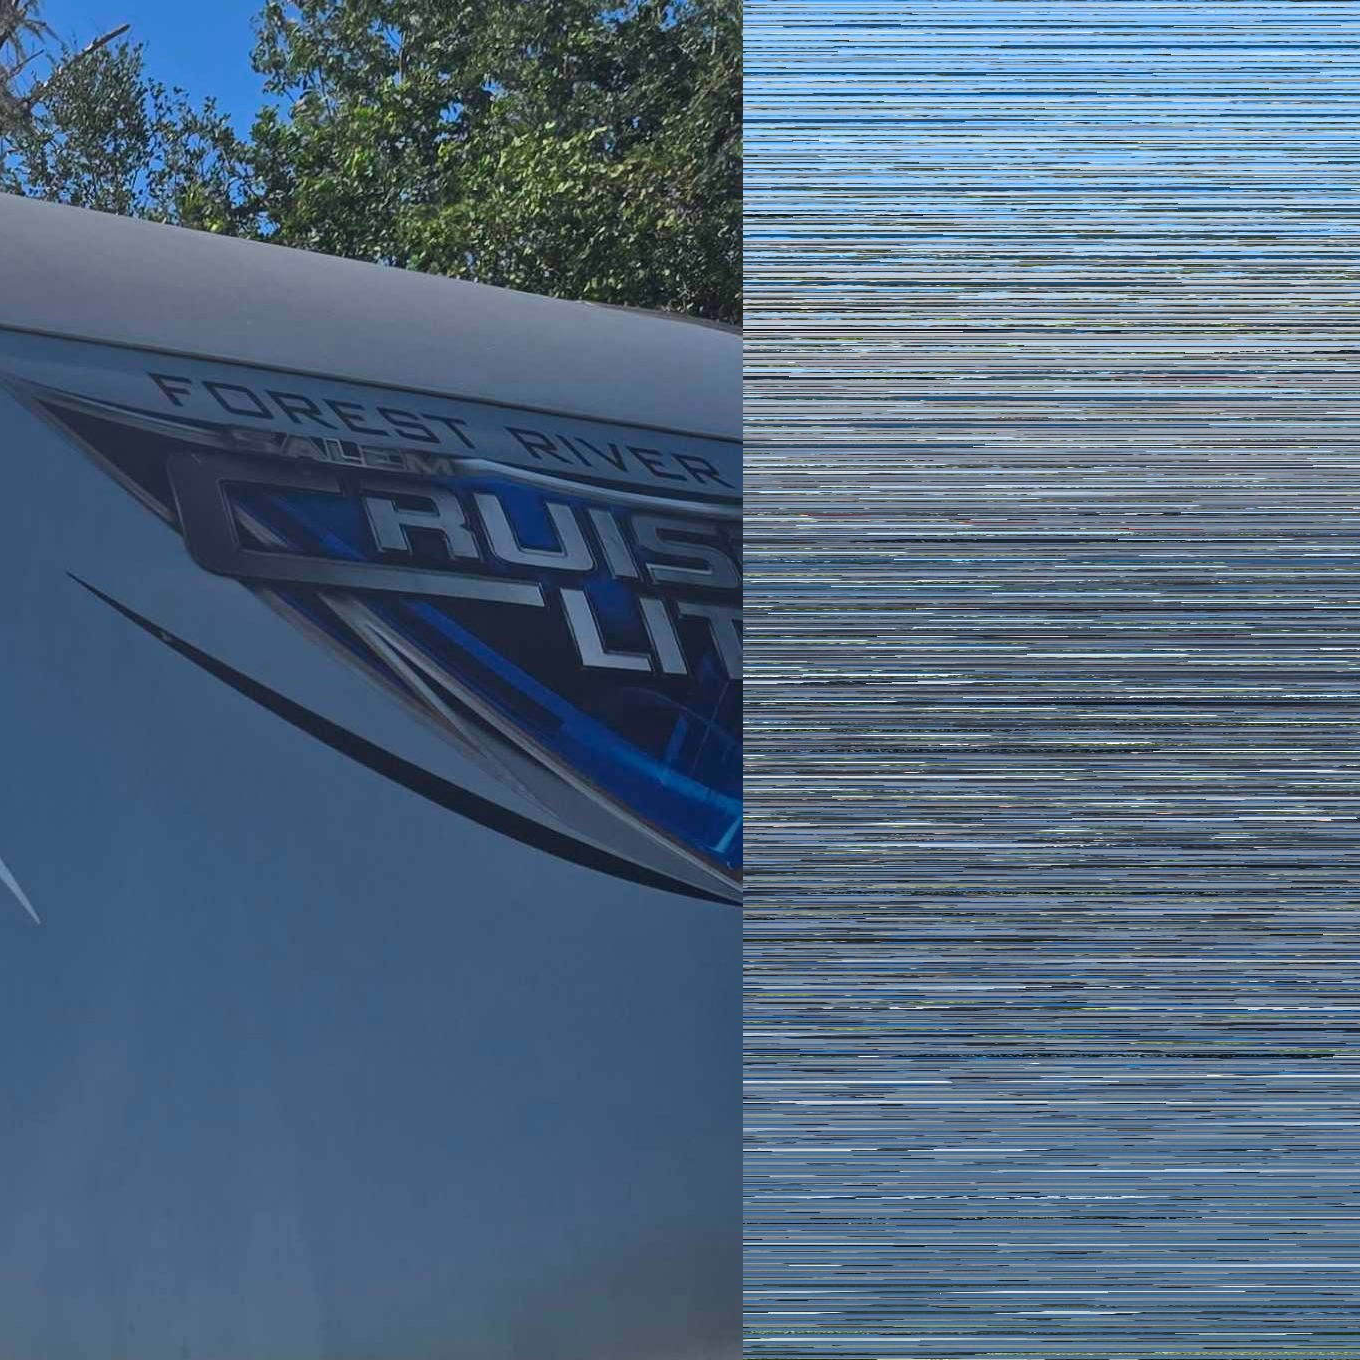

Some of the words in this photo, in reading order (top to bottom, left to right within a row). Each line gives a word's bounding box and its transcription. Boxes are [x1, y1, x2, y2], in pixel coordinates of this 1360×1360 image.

[146, 372, 476, 449] FOREST
[503, 426, 736, 489] RIVER
[230, 427, 455, 476] SALEM
[165, 452, 743, 608] CRUIS
[559, 587, 743, 681] LIT
